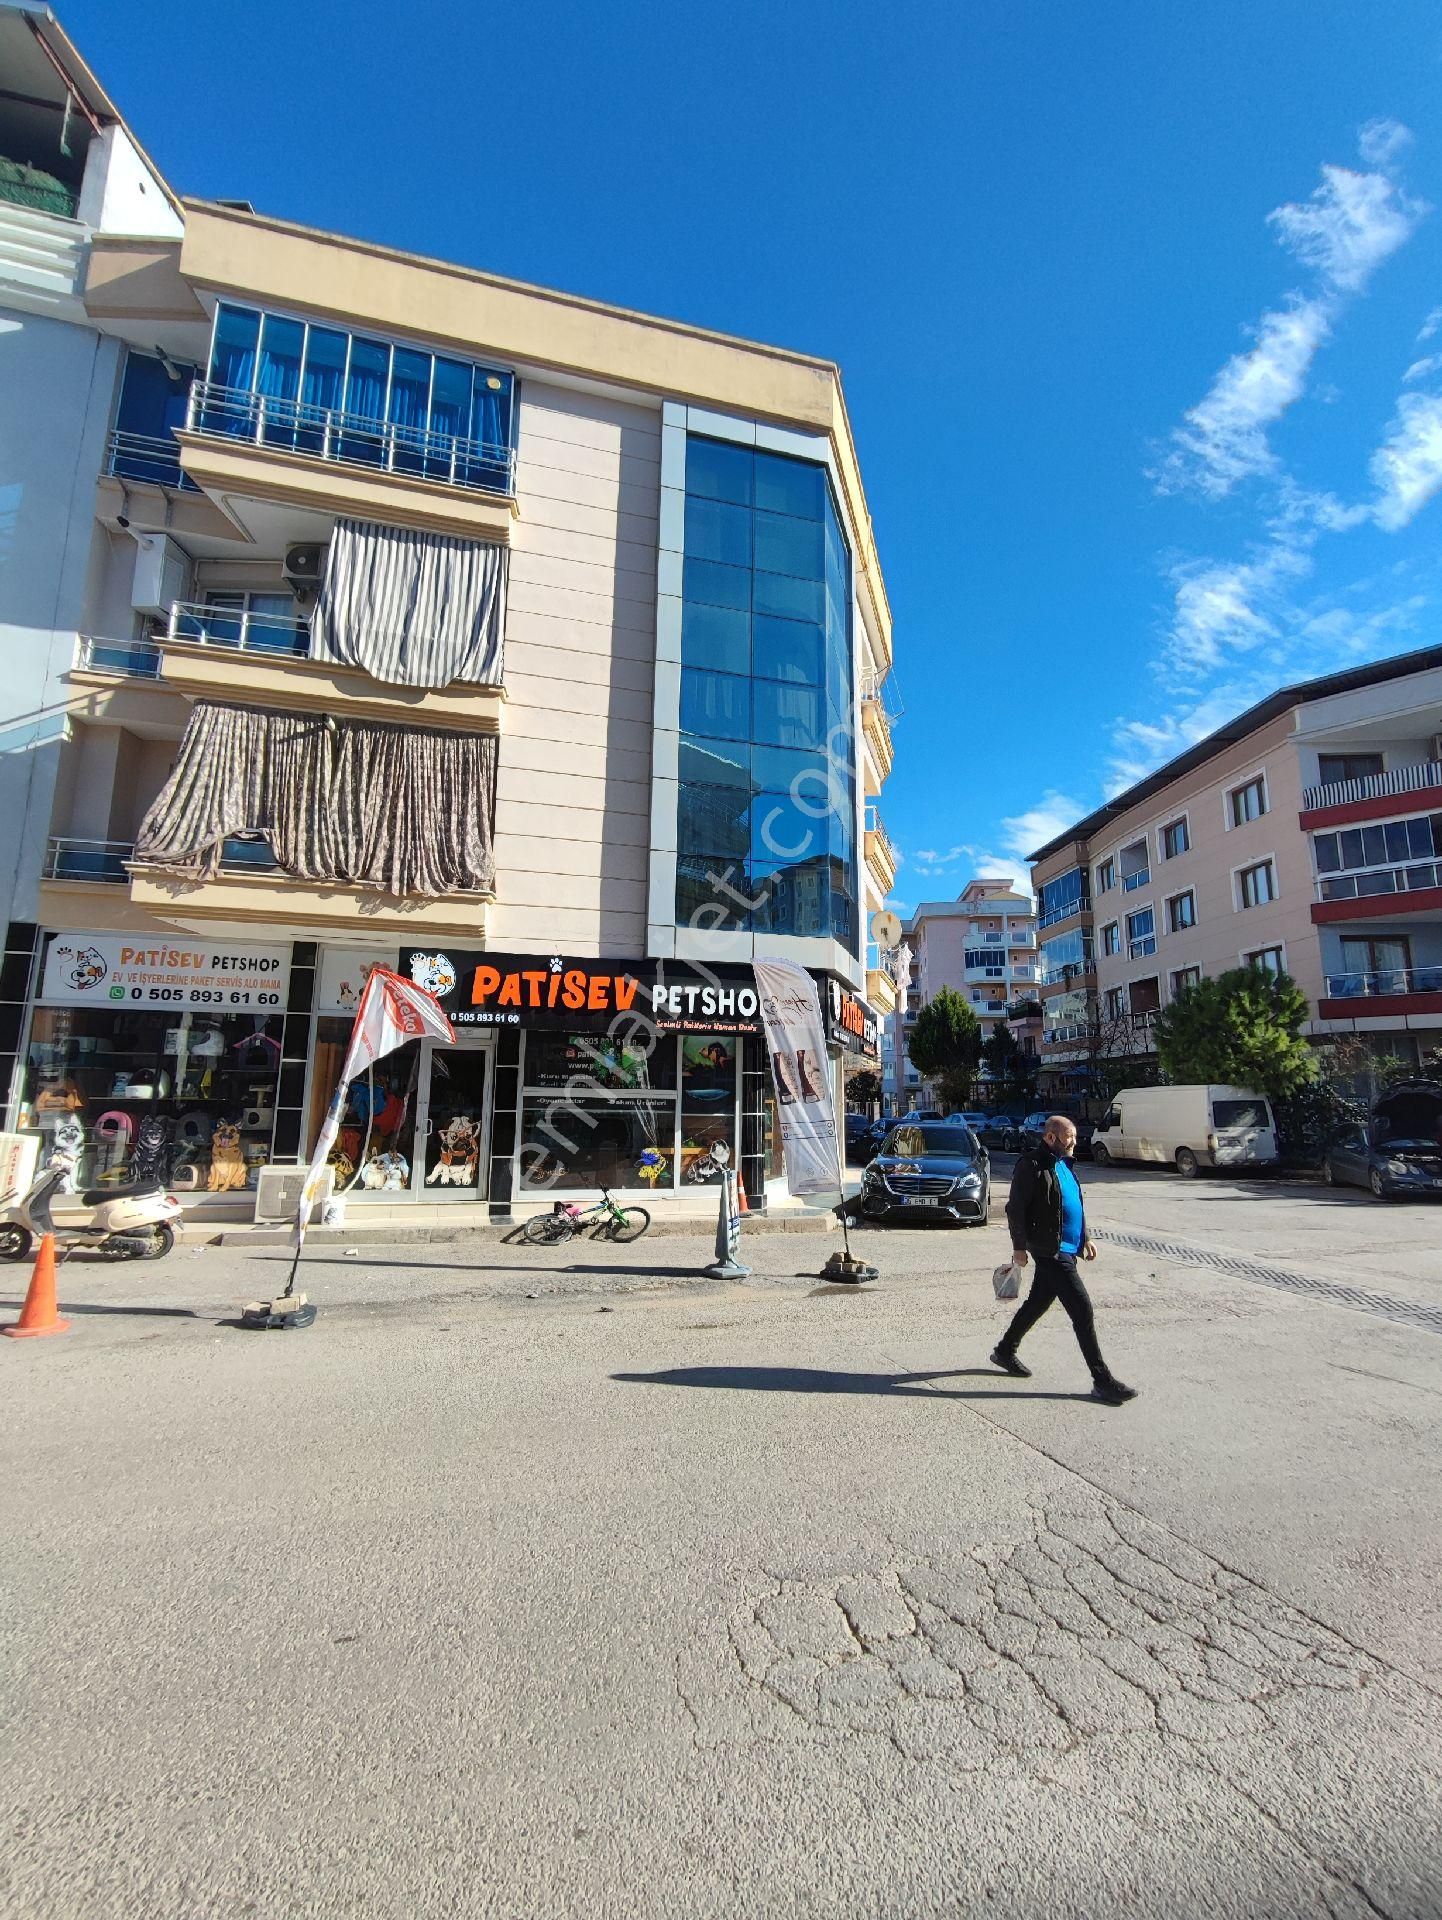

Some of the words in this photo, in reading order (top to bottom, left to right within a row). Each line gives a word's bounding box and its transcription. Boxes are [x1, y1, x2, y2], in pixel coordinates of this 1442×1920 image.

[120, 945, 205, 969] PATİSEV
[211, 955, 280, 972] PETSHOP
[112, 972, 123, 983] EV
[127, 973, 139, 983] VE
[139, 972, 190, 986] İŞYERLERİNE
[190, 977, 215, 987] PAKET
[216, 976, 243, 988] SERVİS
[243, 979, 259, 988] ALO
[259, 980, 281, 990] MAMA
[131, 987, 143, 1000] 0
[149, 988, 184, 1001] 505
[189, 990, 223, 1003] 893
[230, 991, 250, 1004] 61
[257, 993, 280, 1005] 60
[652, 984, 758, 1017] PETSHO
[450, 1013, 457, 1022] 0
[458, 1014, 475, 1023] 505
[476, 1014, 493, 1023] 893
[495, 1014, 505, 1023] 61
[507, 1014, 519, 1024] 60
